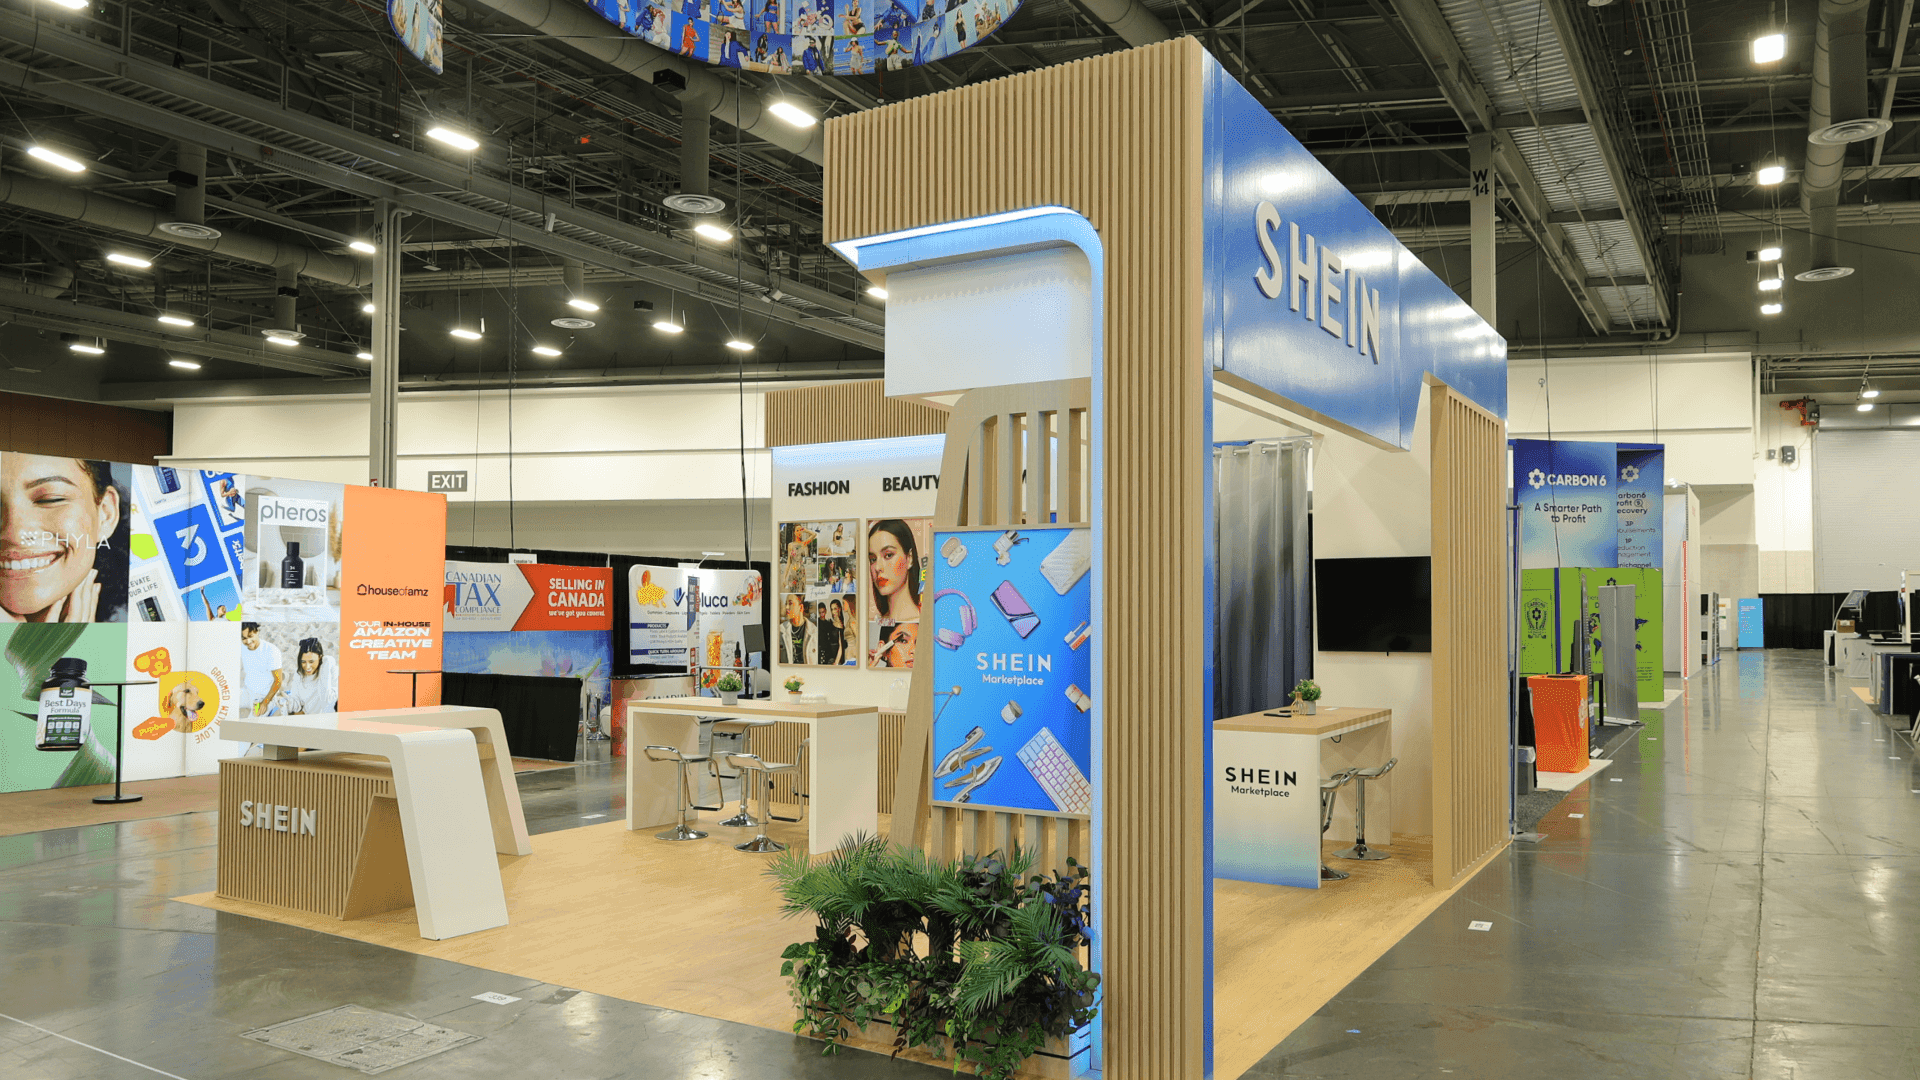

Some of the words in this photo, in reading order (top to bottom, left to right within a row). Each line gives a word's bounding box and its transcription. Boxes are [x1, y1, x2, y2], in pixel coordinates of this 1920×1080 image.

[1472, 169, 1488, 183] W
[1472, 182, 1490, 197] 14
[374, 221, 384, 234] W
[374, 233, 383, 246] 13
[1253, 201, 1380, 365] SHEIN
[431, 474, 465, 489] EXIT
[788, 480, 850, 497] FASHION
[882, 474, 940, 492] BEAUTY
[260, 500, 327, 523] pheros
[1534, 502, 1541, 512] A
[1543, 503, 1580, 513] Smarter
[1581, 503, 1603, 513] Path
[1550, 514, 1560, 523] to
[1562, 513, 1587, 523] Profit
[41, 531, 111, 550] PHYLA
[445, 571, 502, 583] CANADIAN
[549, 577, 593, 590] SELLING
[595, 579, 605, 591] IN
[368, 584, 429, 597] houseofamz
[445, 581, 502, 607] TAX
[548, 591, 605, 607] CANADA
[455, 606, 502, 614] COMPLIANCE
[548, 609, 565, 617] we've
[565, 609, 575, 619] got
[575, 610, 586, 619] you
[353, 620, 381, 628] YOUR
[352, 627, 431, 637] AMAZON
[349, 638, 433, 649] CREATIVE
[366, 649, 417, 660] TEAM
[976, 652, 1052, 673] SHEIN
[210, 666, 231, 701] GROOMED
[981, 673, 1045, 687] Marketplace
[44, 699, 64, 708] Best
[65, 699, 87, 708] Days
[1225, 766, 1297, 787] SHEIN
[1230, 785, 1290, 798] Marketplace
[240, 800, 317, 838] SHEIN
